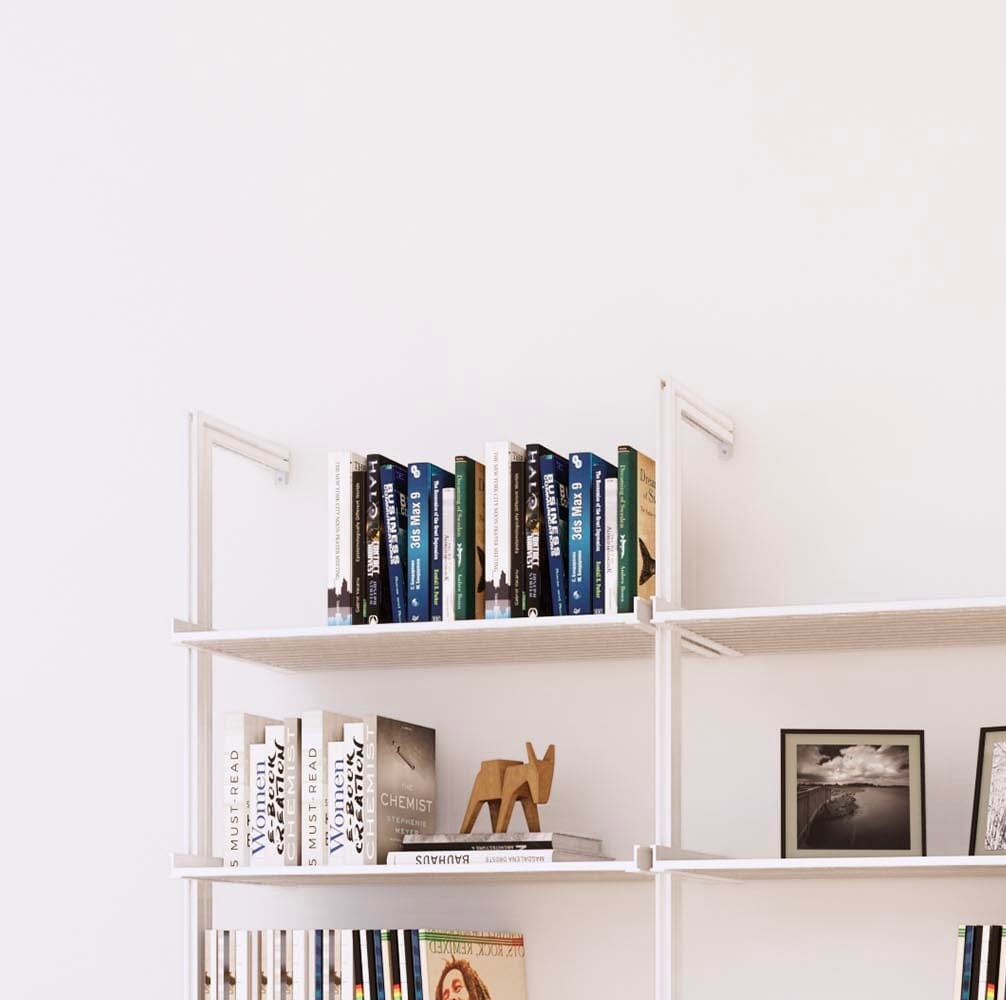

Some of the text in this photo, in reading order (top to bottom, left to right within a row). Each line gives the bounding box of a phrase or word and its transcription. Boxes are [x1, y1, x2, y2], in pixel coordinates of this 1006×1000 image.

[369, 460, 378, 519] HALO
[387, 483, 400, 565] BUSINESS
[411, 503, 421, 526] Max
[528, 450, 538, 510] HALO
[548, 474, 560, 557] BUSINESS
[572, 494, 582, 517] Max
[410, 529, 421, 548] 3ds
[572, 521, 582, 540] 3ds
[230, 750, 239, 850] MUST-READ
[252, 761, 266, 855] Women
[267, 751, 276, 844] E-BOOK
[275, 738, 285, 855] CREATION
[287, 729, 296, 860] CHEMIST
[309, 748, 317, 849] MUST-READ
[330, 759, 344, 855] Women
[346, 749, 355, 843] E-BOOK
[353, 736, 363, 854] CREATION
[366, 729, 374, 859] CHEMIST
[381, 793, 432, 813] CHEMIST
[416, 855, 469, 865] BAUHAUS
